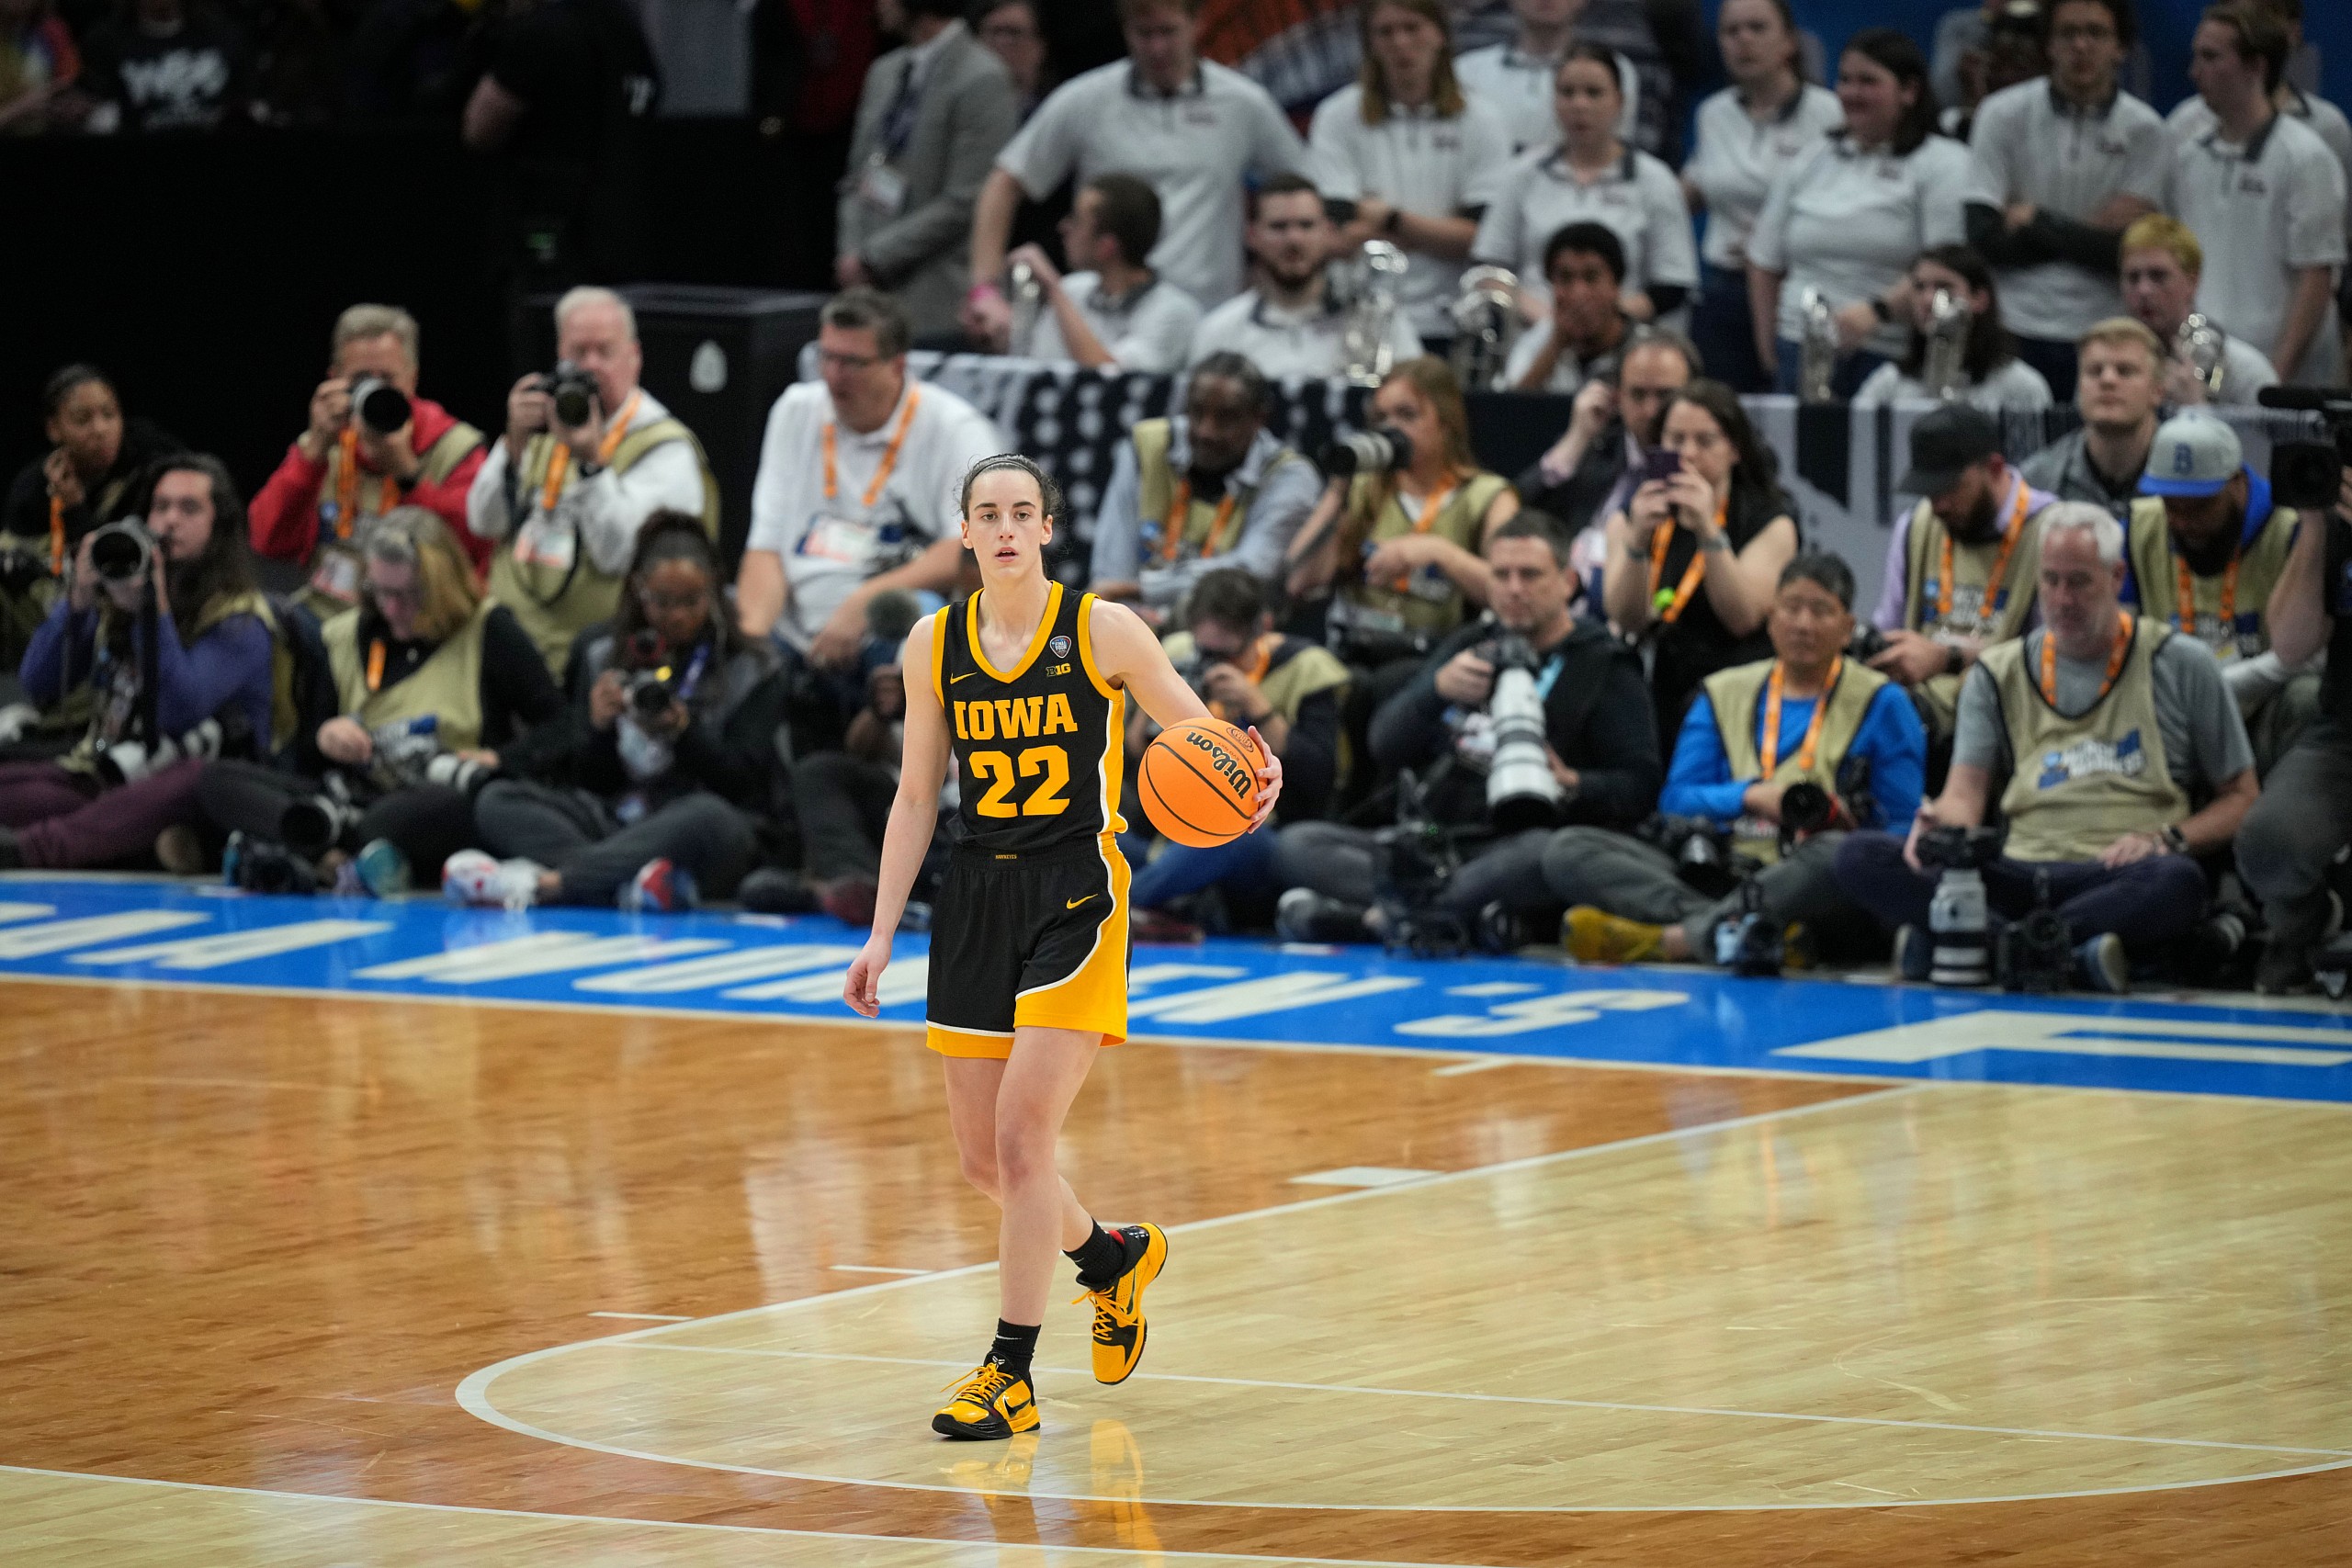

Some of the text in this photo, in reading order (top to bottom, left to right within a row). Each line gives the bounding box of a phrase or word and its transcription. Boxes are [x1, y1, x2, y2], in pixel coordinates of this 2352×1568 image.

[954, 694, 1079, 740] IOWA
[968, 745, 1070, 818] 22
[1186, 731, 1252, 800] Wilson
